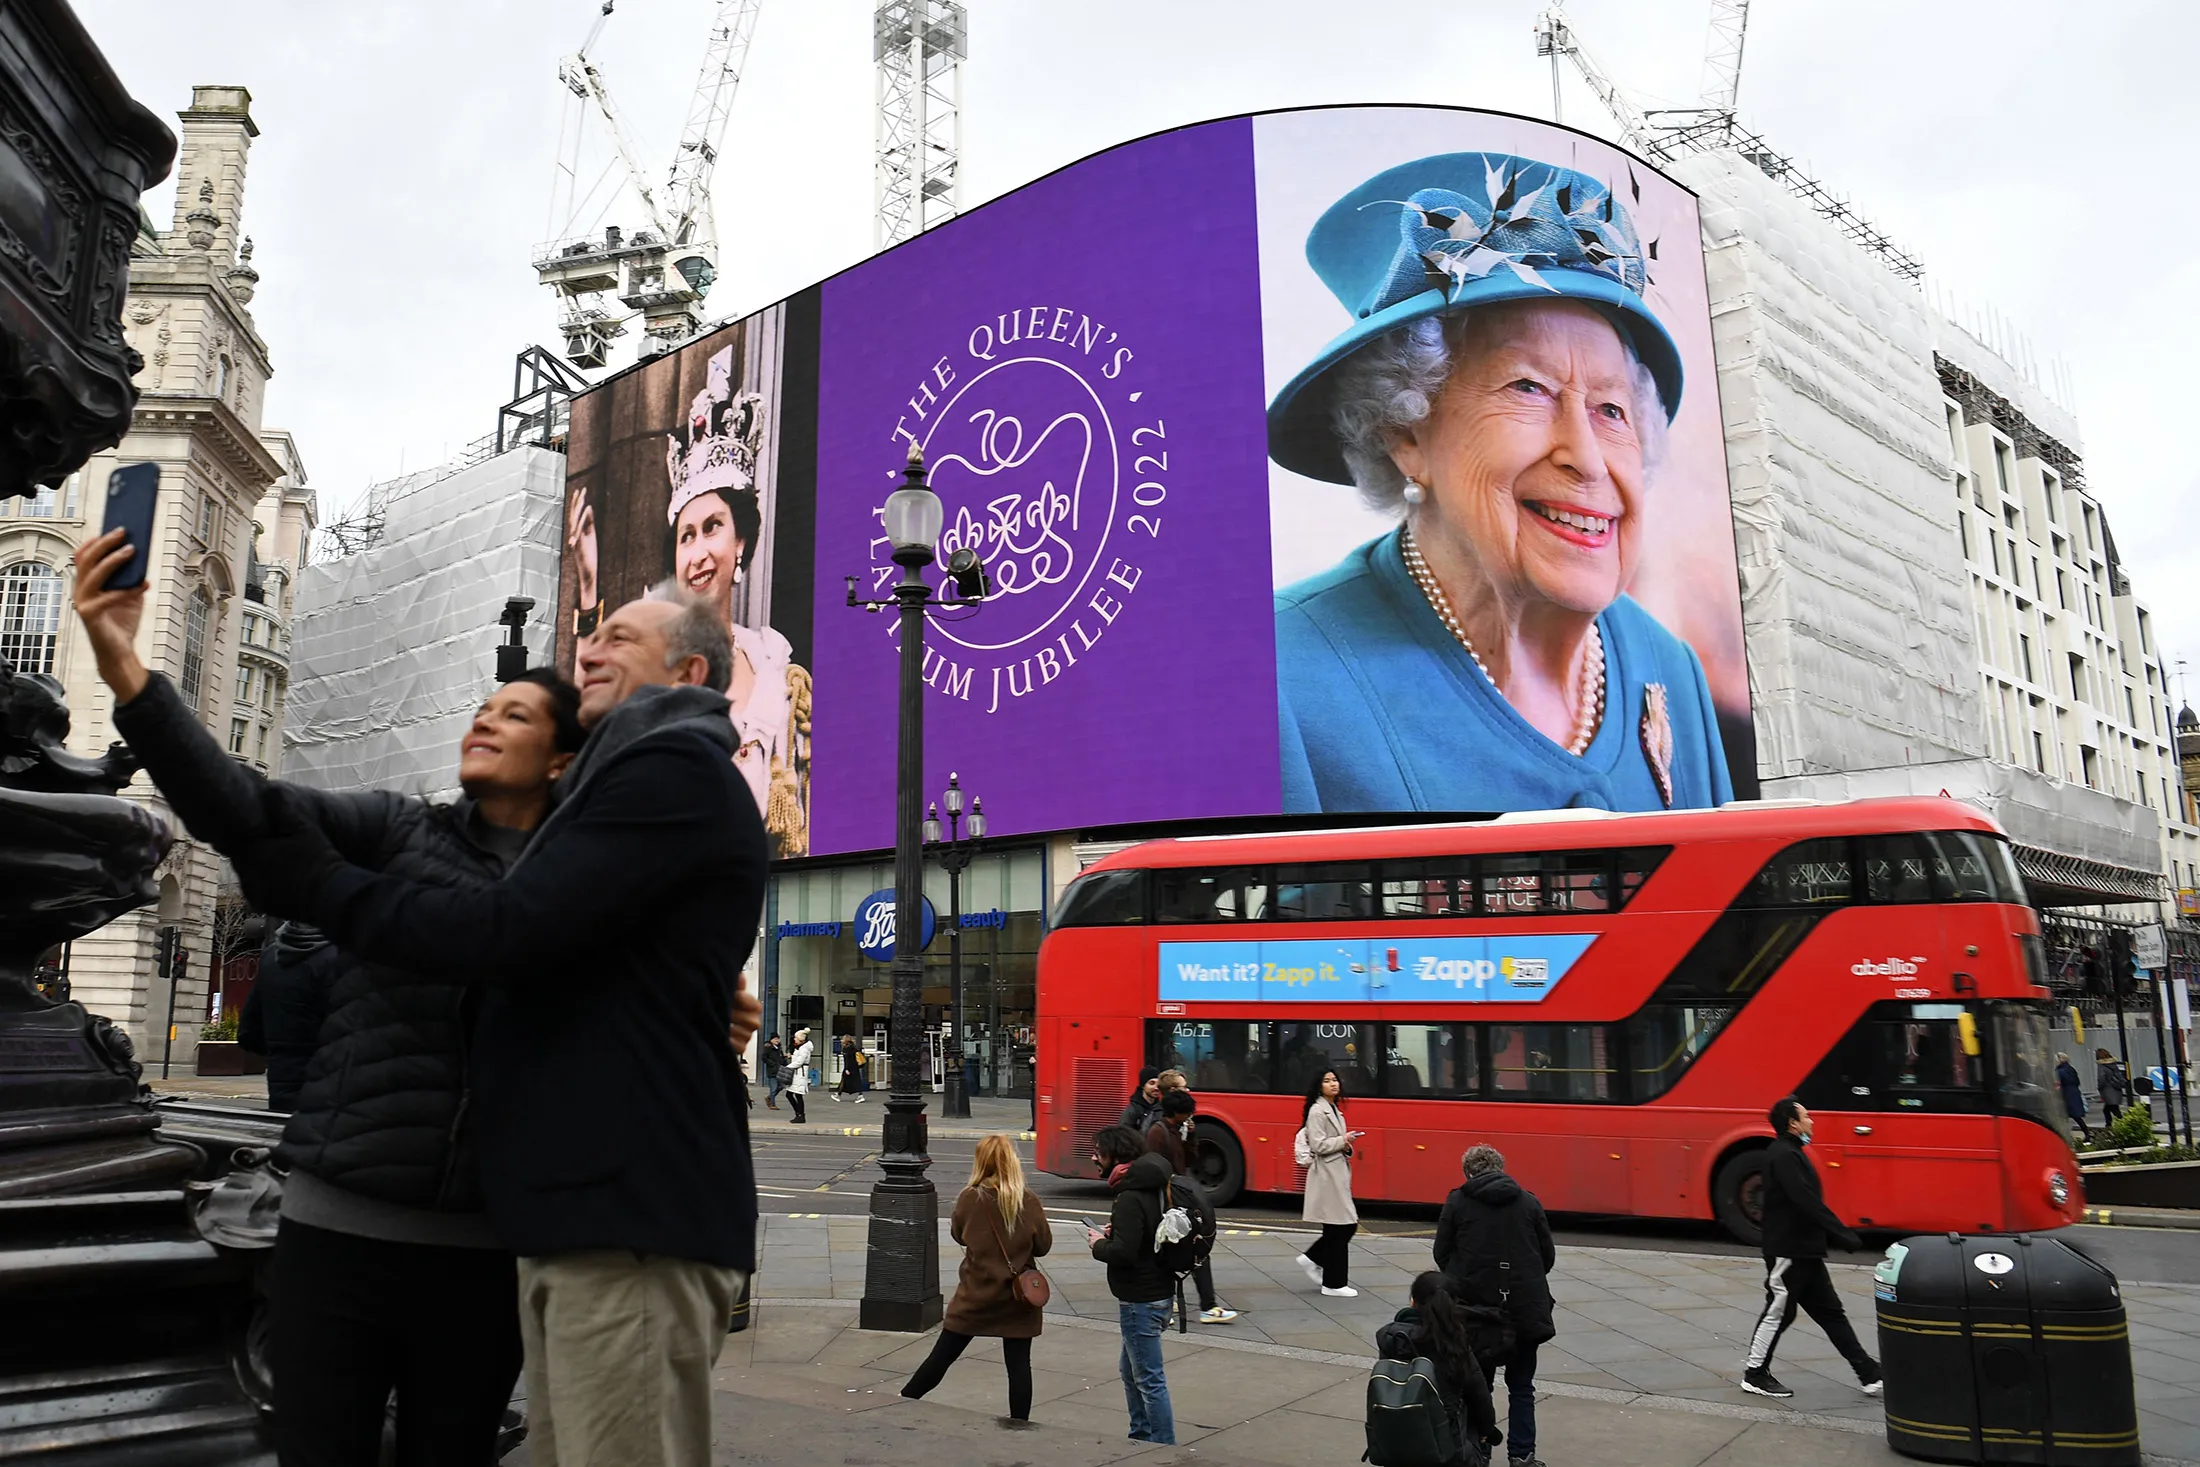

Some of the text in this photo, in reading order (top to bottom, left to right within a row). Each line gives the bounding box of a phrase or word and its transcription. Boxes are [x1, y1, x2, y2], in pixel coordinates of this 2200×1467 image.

[891, 306, 1134, 444] THE QUEEN'S
[986, 557, 1143, 714] JUBILEE
[1127, 419, 1168, 539] 2022
[777, 920, 842, 940] pharmacy
[959, 908, 1007, 931] eauty
[1177, 961, 1341, 987] Want it? Zapp it.
[1416, 956, 1497, 988] Zapp
[1851, 957, 1919, 976] abellio
